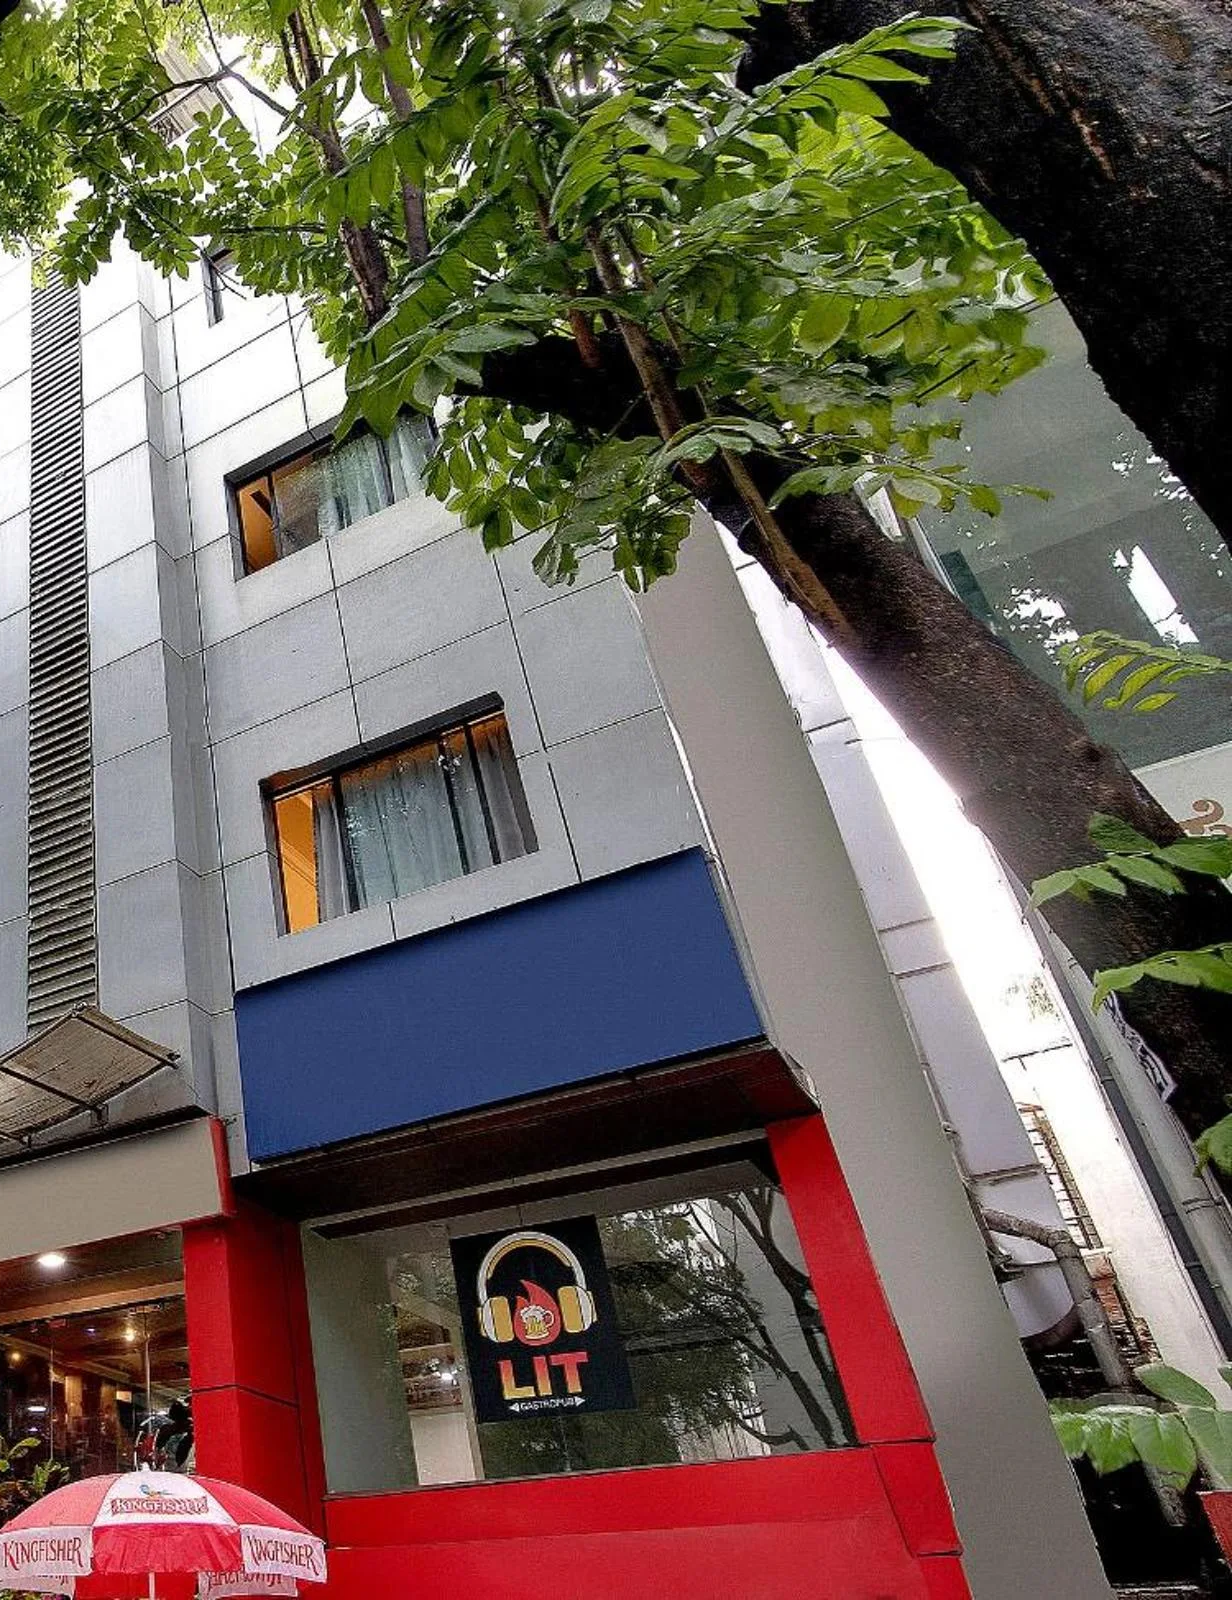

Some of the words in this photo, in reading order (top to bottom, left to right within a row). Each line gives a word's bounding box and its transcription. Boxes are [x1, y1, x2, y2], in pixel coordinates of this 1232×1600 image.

[497, 1351, 589, 1400] LIT
[520, 1397, 574, 1411] GASTROPUB
[3, 1537, 84, 1571] KINGFISHER
